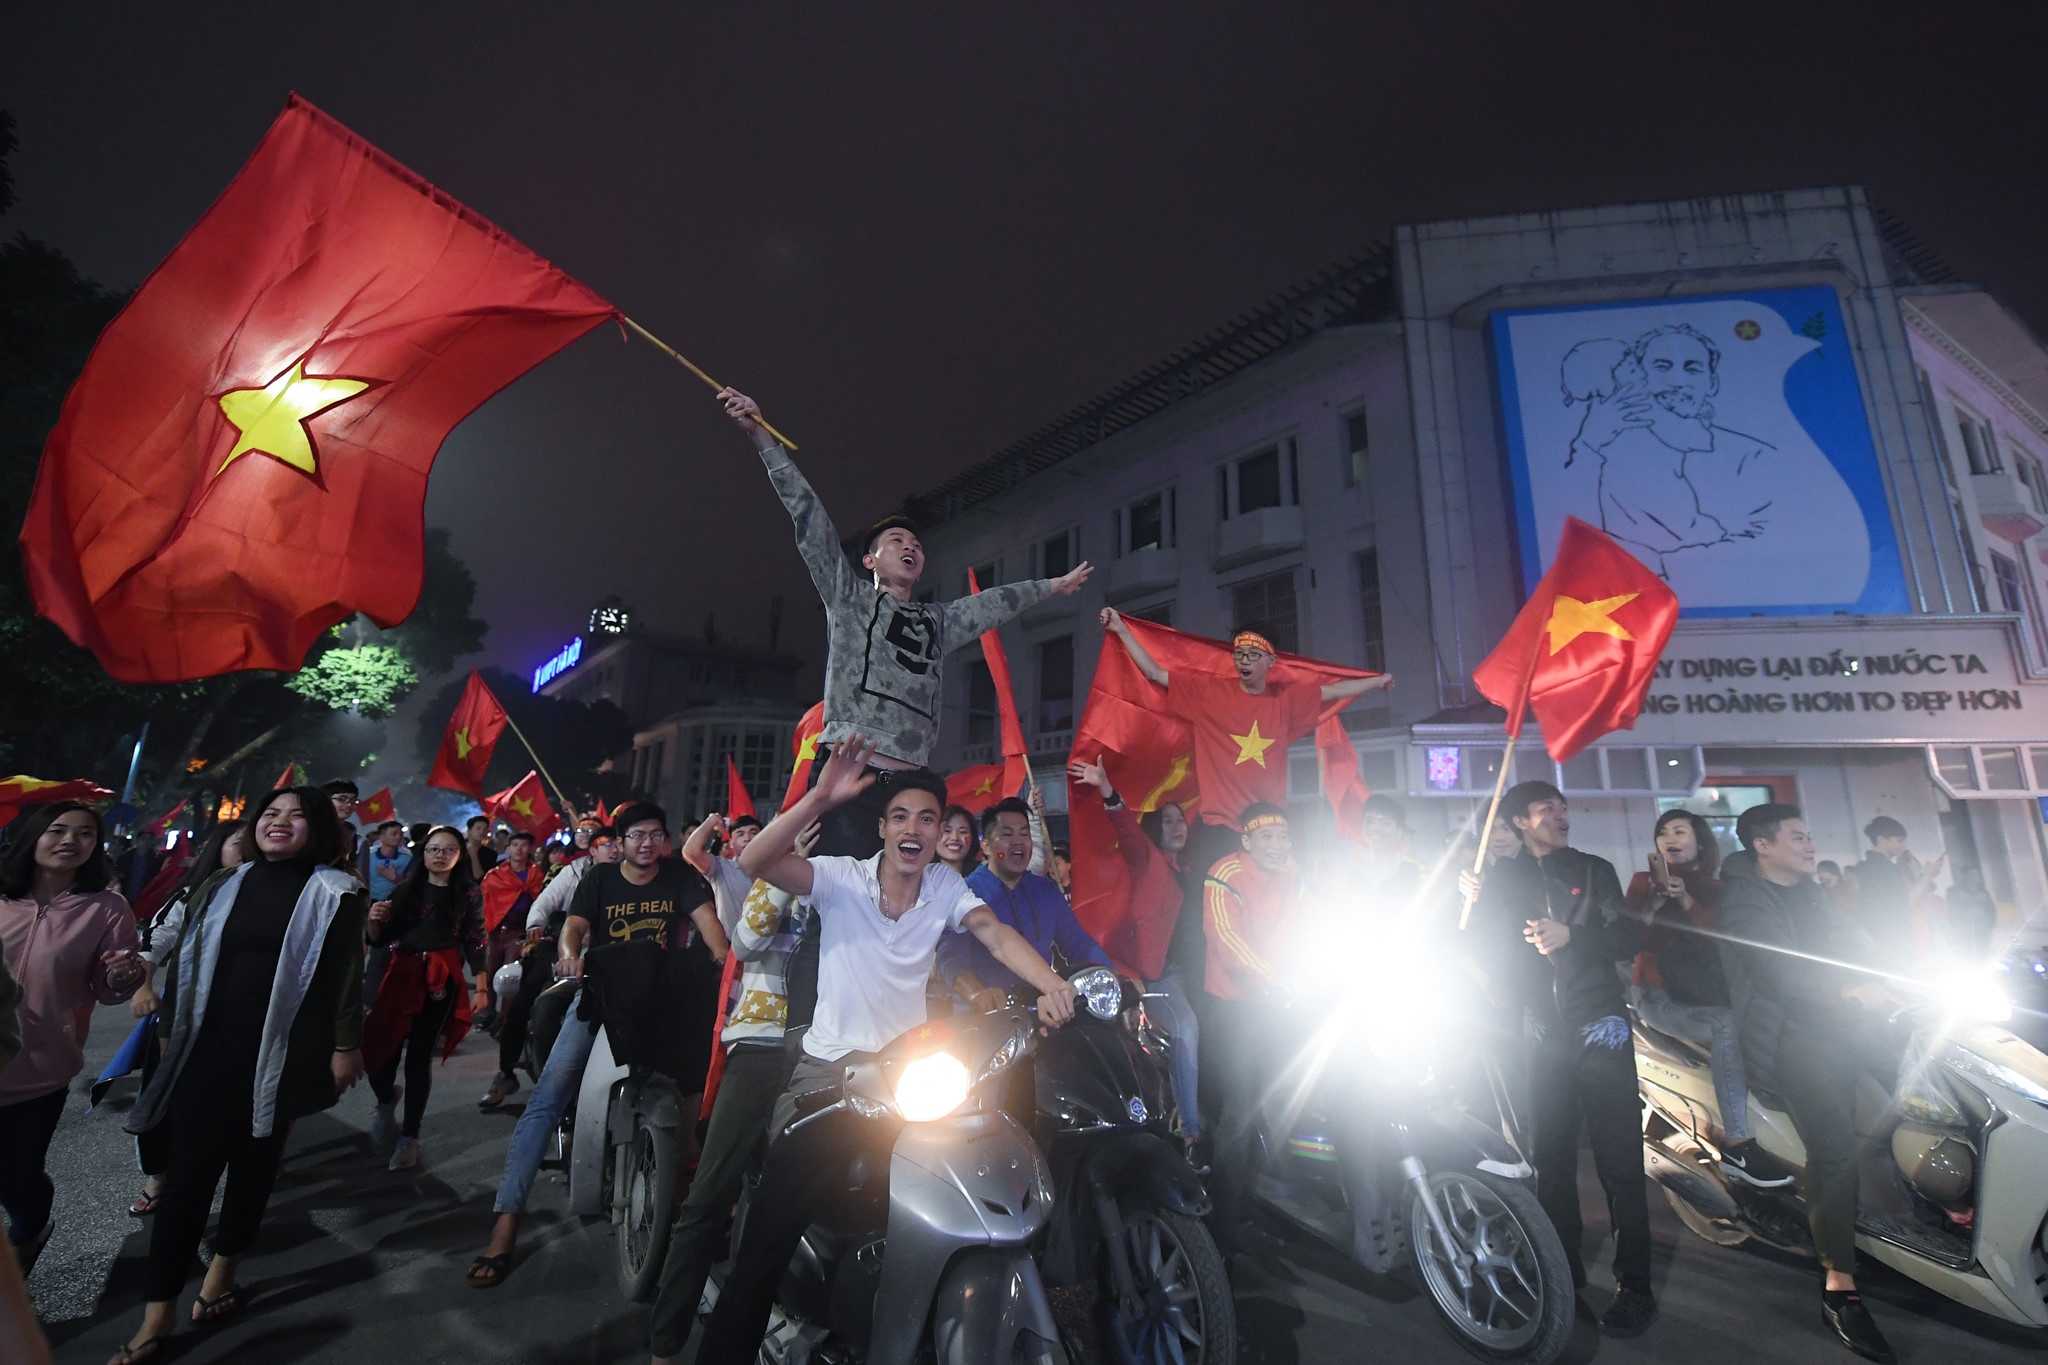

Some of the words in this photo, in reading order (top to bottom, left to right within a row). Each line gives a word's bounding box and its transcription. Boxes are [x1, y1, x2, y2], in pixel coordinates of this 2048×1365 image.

[1680, 657, 1758, 683] DỰNG
[1761, 656, 1803, 681] LẠI
[1808, 648, 1859, 677] ĐẤT
[1863, 647, 1947, 676] NƯỚC
[1949, 653, 1988, 675] TA
[1641, 694, 1680, 714] NG
[1685, 687, 1788, 714] HOÀNG
[1791, 691, 1856, 713] HƠN
[1857, 691, 1896, 712] TO
[1900, 690, 1953, 717] ĐẸP
[1957, 688, 2022, 711] HƠN
[605, 902, 636, 920] THE
[640, 900, 675, 914] REAL
